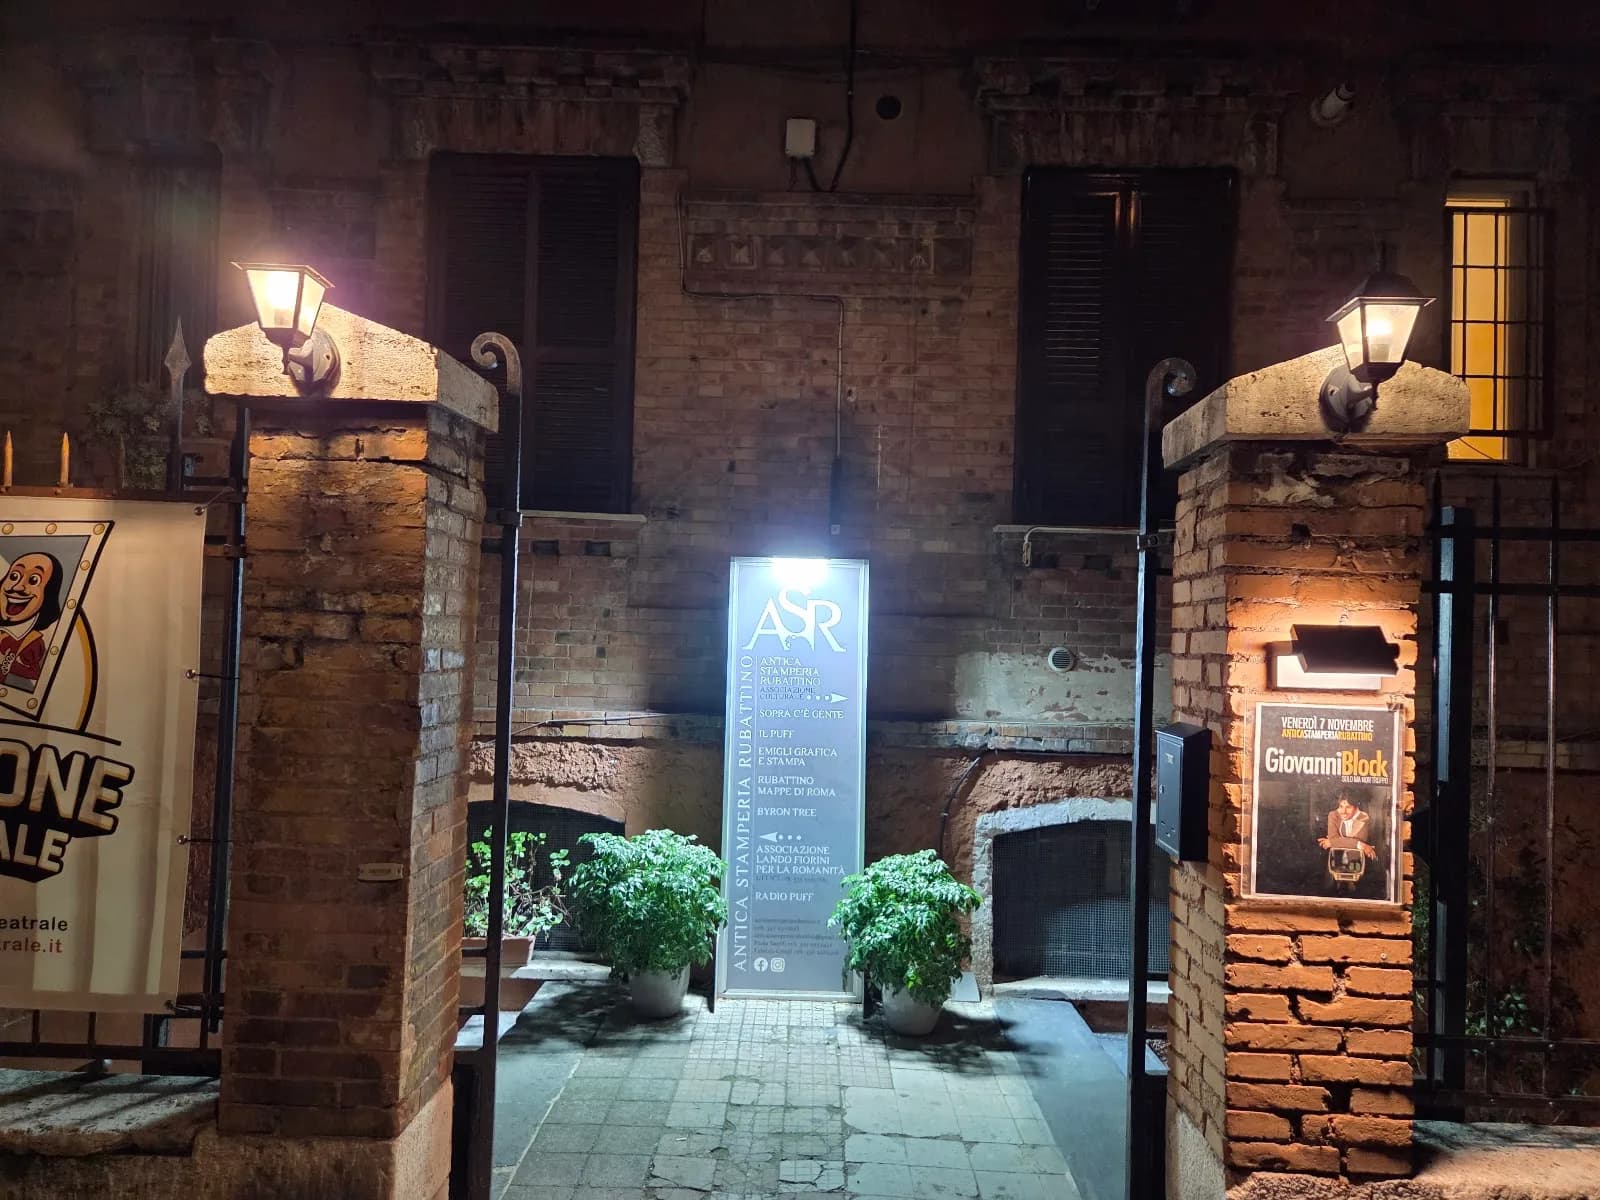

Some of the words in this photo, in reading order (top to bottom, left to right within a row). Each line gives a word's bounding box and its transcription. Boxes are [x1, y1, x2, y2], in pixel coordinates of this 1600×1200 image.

[741, 586, 847, 652] ASR
[760, 656, 801, 666] ANTICA
[760, 666, 819, 676] STAMPERIA
[760, 676, 820, 686] RUBATTINO
[738, 655, 753, 768] RUBATTINO
[760, 710, 791, 718] SOPRA
[812, 710, 844, 719] GENTE
[1282, 716, 1316, 729] VENERDÌ
[1319, 719, 1325, 729] 7
[1327, 719, 1374, 732] NOVEMBRE
[760, 730, 768, 738] IL
[770, 730, 794, 738] PUFF
[759, 747, 792, 756] EMIGLI
[794, 748, 838, 757] GRAFICA
[758, 757, 765, 765] E
[767, 757, 806, 766] STAMPA
[758, 776, 814, 784] RUBATTINO
[758, 787, 792, 796] MAPPE
[794, 788, 804, 796] DI
[807, 788, 836, 797] ROMA
[758, 808, 790, 816] BYRON
[792, 808, 816, 816] TREE
[735, 777, 751, 888] STAMPERIA
[756, 845, 830, 854] ASSOCIAZIONE
[756, 855, 792, 864] LANDO
[794, 856, 830, 865] FIORINI
[756, 865, 774, 874] PER
[777, 865, 790, 874] LA
[792, 865, 845, 875] ROMANITÀ
[755, 892, 788, 901] RADIO
[790, 893, 815, 902] PUFF
[733, 896, 749, 972] ANTICA
[0, 937, 63, 953] rale.it
